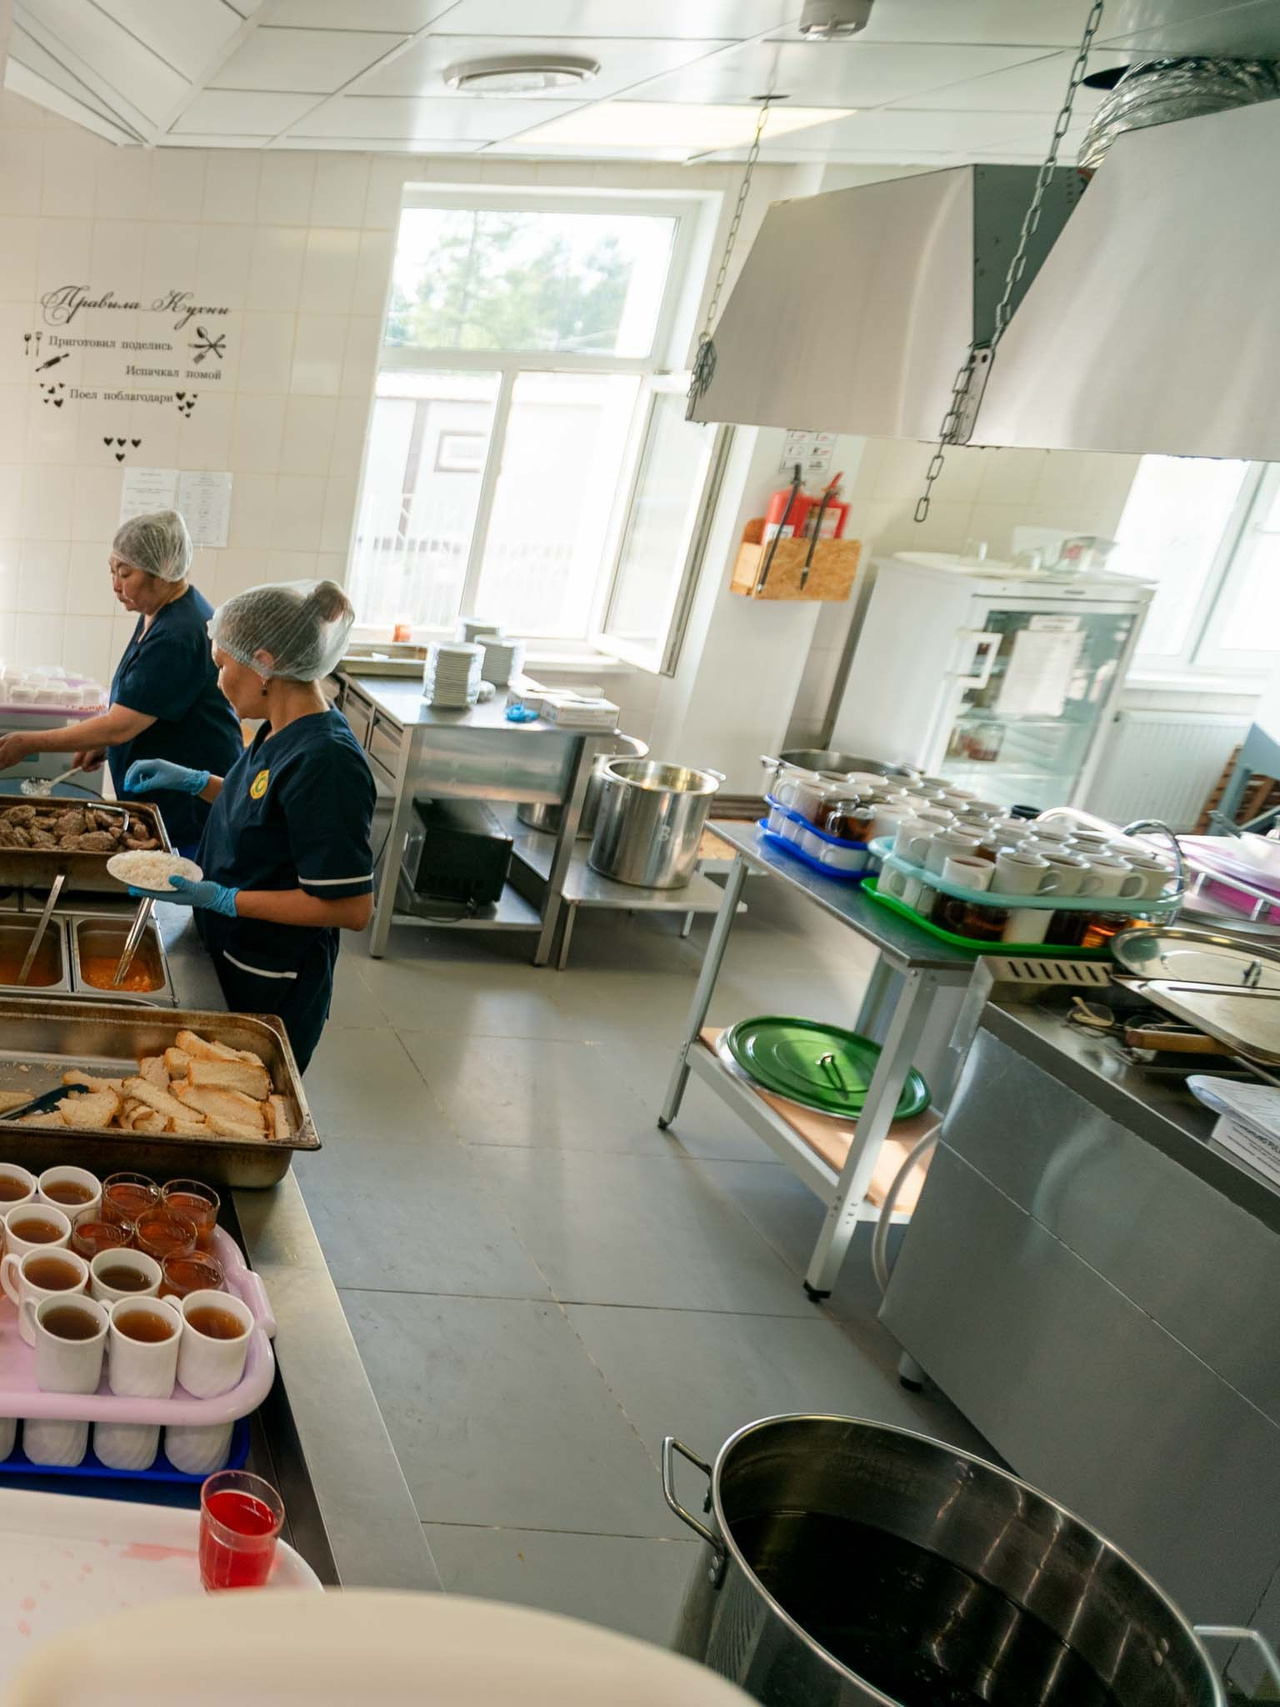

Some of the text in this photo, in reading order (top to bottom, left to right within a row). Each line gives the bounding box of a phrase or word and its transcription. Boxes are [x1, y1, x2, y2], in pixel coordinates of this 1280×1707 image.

[41, 285, 230, 330] Правила Кухни
[48, 335, 174, 351] Приготовил поделись
[126, 365, 222, 380] Испачкал помой
[69, 388, 174, 404] Поел поблагодари
